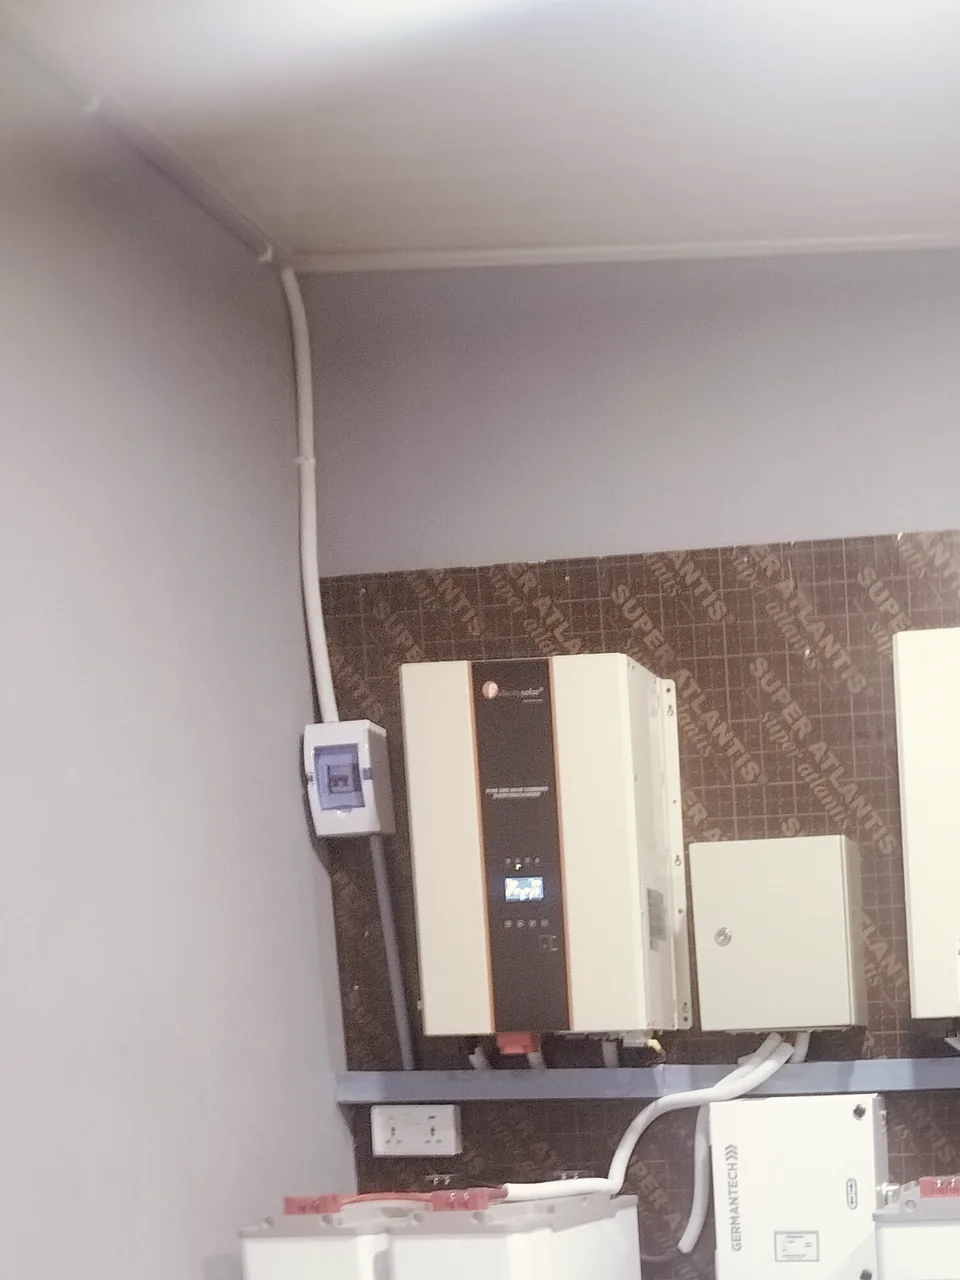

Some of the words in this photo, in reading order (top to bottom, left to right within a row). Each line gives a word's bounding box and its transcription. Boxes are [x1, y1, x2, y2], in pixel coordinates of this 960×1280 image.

[611, 584, 675, 664] SUPER
[672, 668, 761, 783] ATLANTIS
[775, 577, 867, 695] ATLANTIS
[749, 657, 812, 740] SUPER
[808, 741, 898, 856] ATLANTIS
[727, 1162, 742, 1252] GERMANTECH
